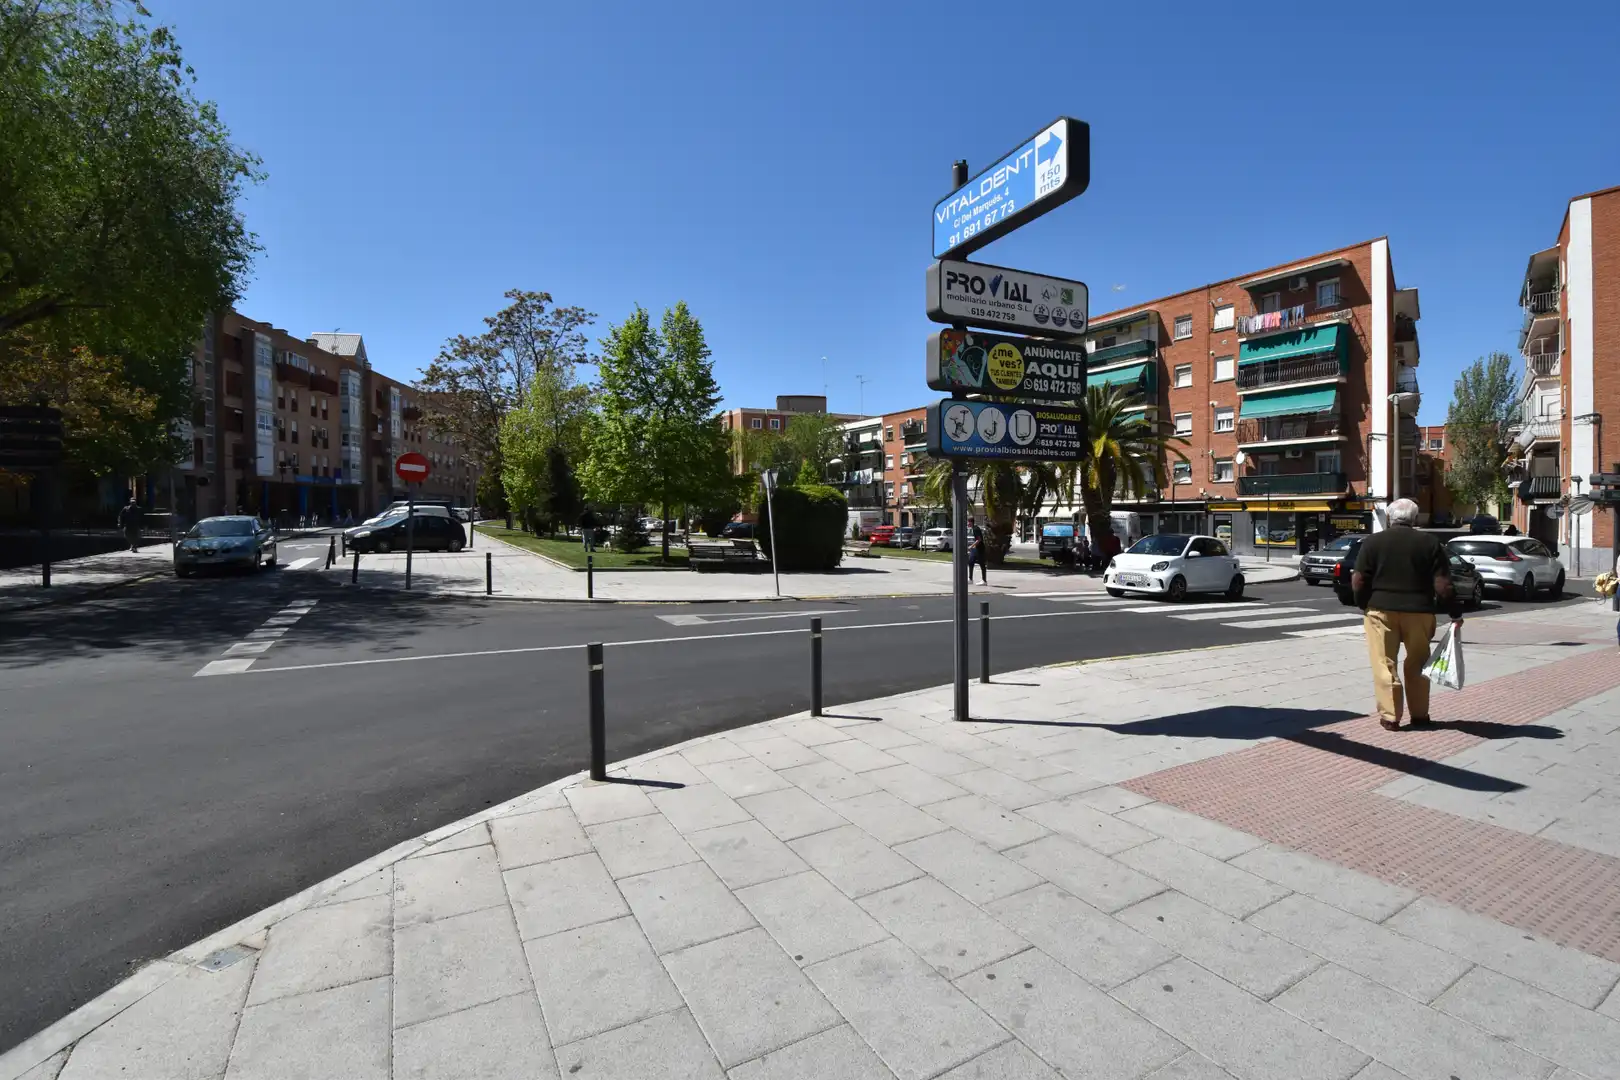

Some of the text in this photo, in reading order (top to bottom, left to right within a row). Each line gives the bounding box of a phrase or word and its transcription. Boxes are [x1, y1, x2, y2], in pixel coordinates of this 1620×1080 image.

[1040, 164, 1061, 183] 150
[936, 148, 1034, 224] VITALDENT
[1039, 177, 1061, 194] mts
[961, 211, 972, 224] Del
[1004, 186, 1010, 197] 4
[949, 199, 1015, 247] 91 691 67 73
[946, 293, 987, 306] mobiliario
[988, 299, 1016, 310] urbano
[971, 307, 1016, 321] 619 472 758
[992, 348, 1013, 360] ¿me
[1023, 345, 1082, 362] ANÚNCIATE
[1000, 359, 1022, 369] ves?
[1026, 361, 1080, 379] AQUÍ
[1033, 378, 1082, 394] 619 472 758
[1036, 411, 1081, 421] BIOSALUDABLES
[1040, 439, 1054, 447] 619
[1054, 440, 1067, 448] 472
